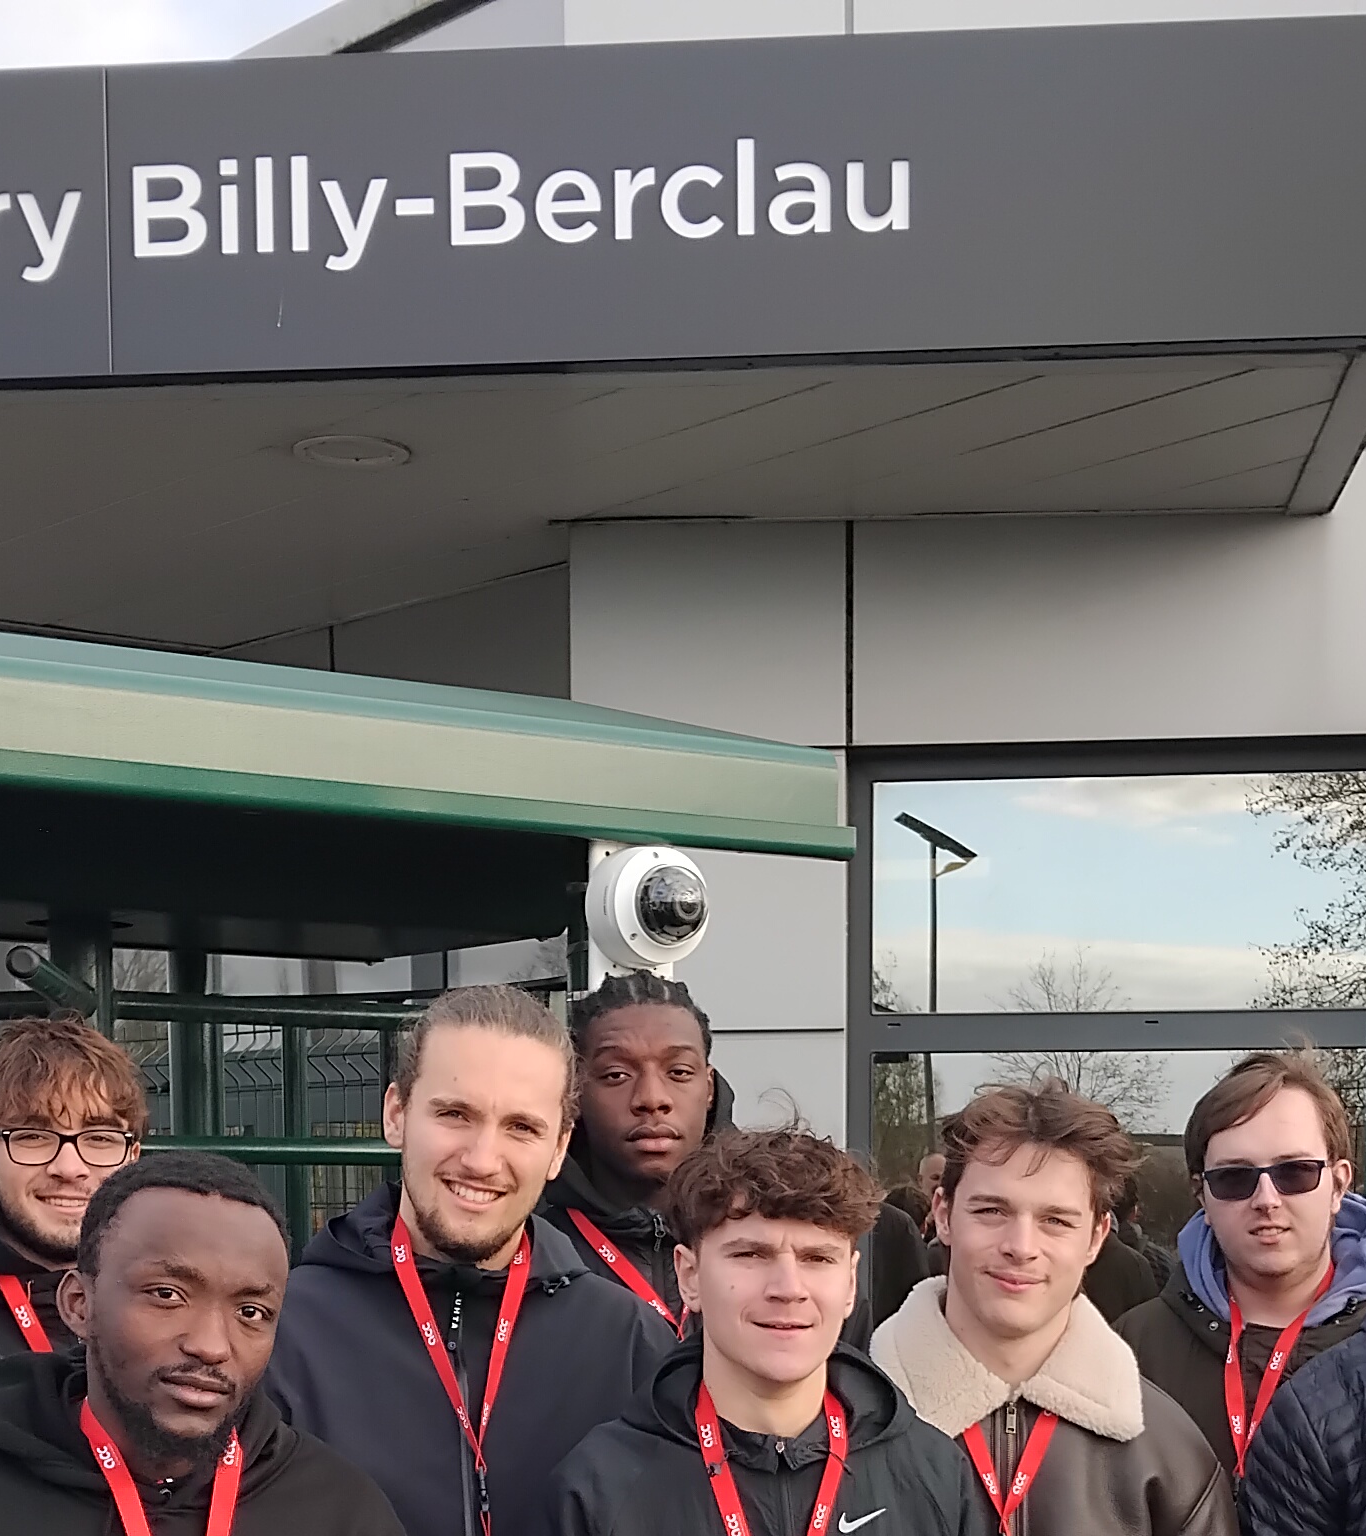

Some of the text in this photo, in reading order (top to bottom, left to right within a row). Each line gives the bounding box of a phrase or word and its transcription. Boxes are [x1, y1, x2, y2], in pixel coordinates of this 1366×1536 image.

[131, 138, 910, 271] Billy-Berclau
[599, 1245, 615, 1262] acc
[15, 1306, 31, 1328] acc
[421, 1322, 436, 1346] acc
[497, 1318, 508, 1342] acc
[1270, 1351, 1283, 1370] acc
[700, 1424, 713, 1448] acc
[830, 1416, 841, 1438] acc
[96, 1446, 116, 1469] acc
[983, 1473, 996, 1494] acc
[1013, 1472, 1026, 1494] acc
[813, 1504, 826, 1529] acc
